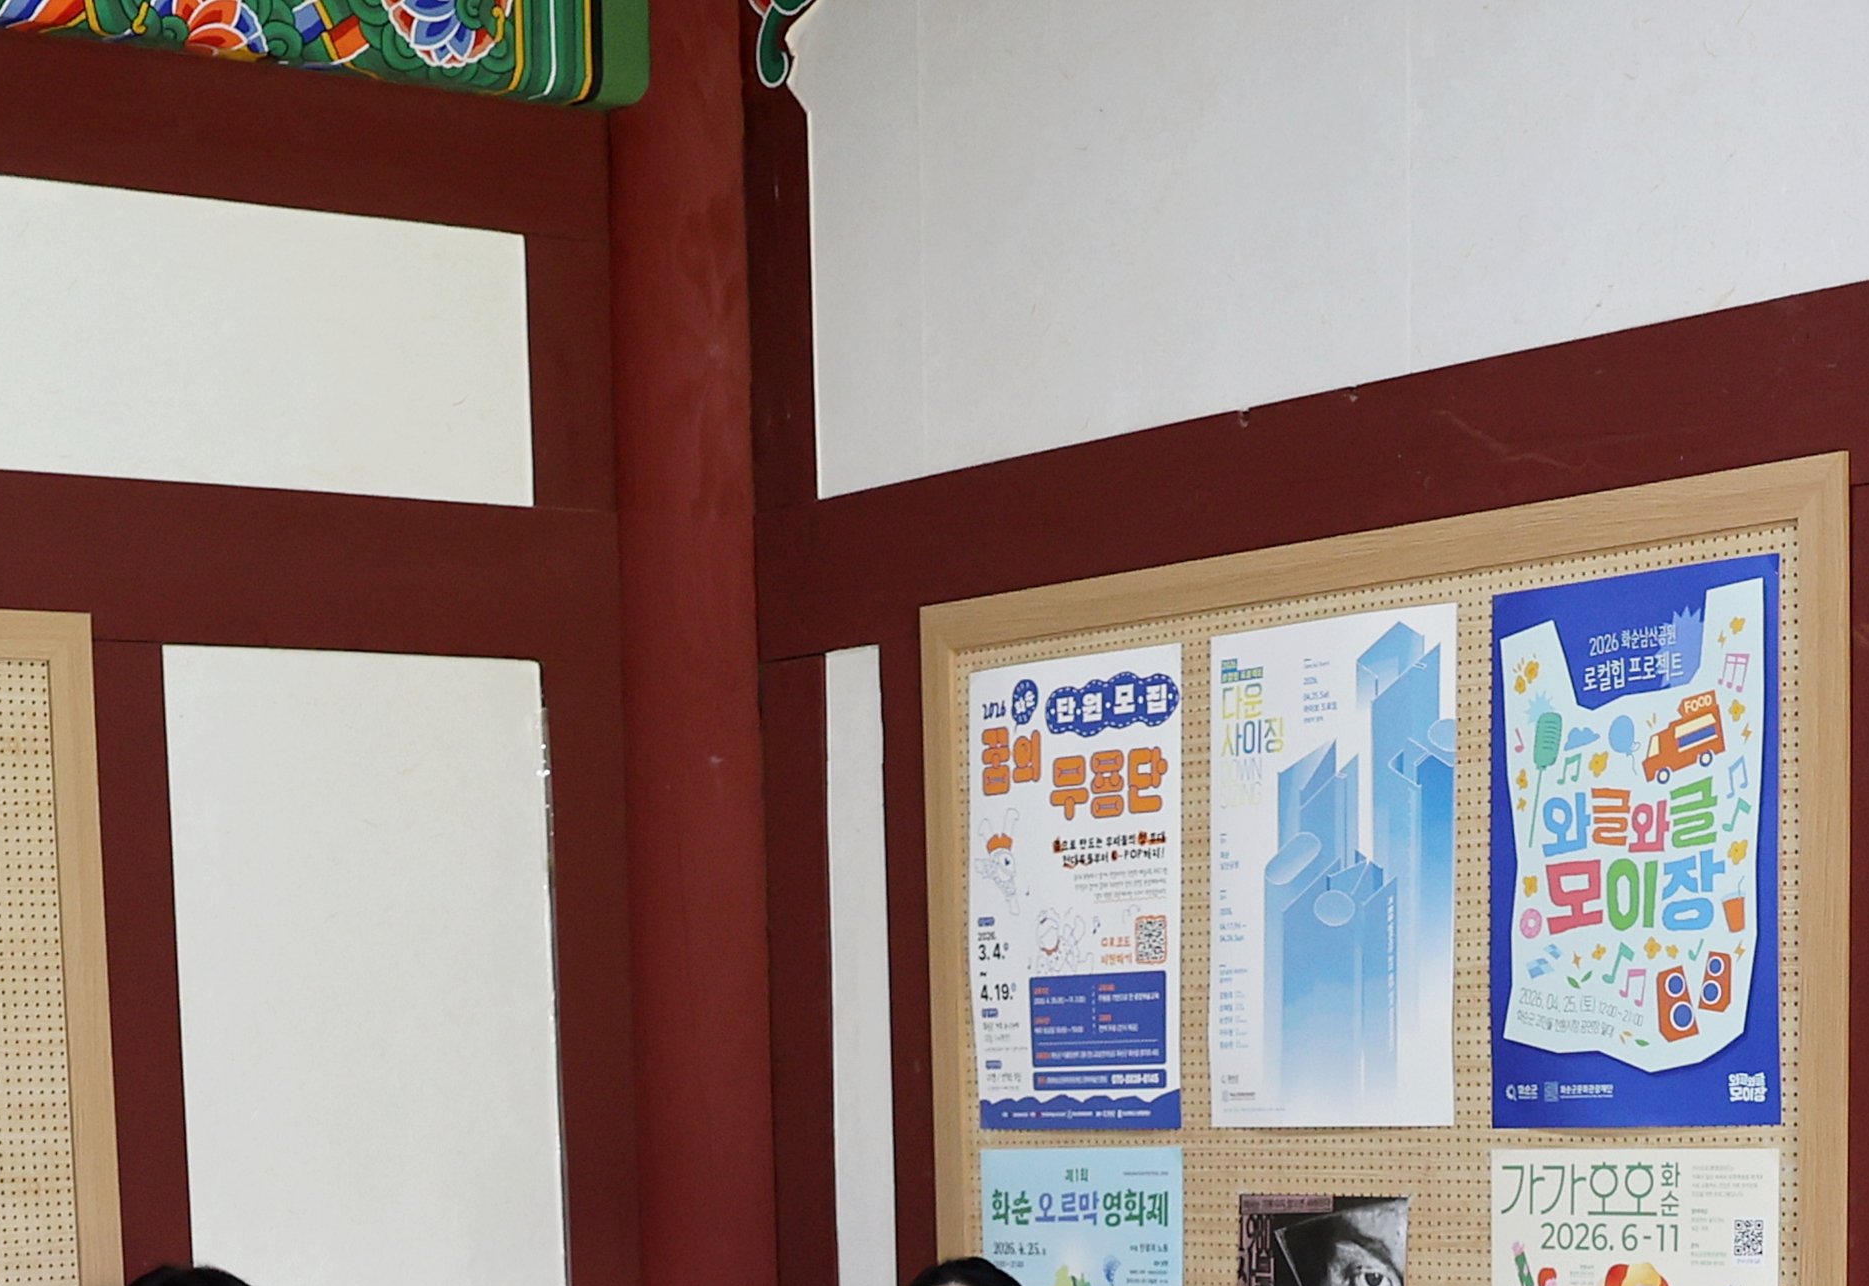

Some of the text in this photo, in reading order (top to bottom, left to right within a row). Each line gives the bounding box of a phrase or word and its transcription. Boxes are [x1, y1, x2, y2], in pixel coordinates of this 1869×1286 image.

[1588, 622, 1678, 657] 2026 화순남산공원
[1583, 653, 1684, 693] 로컬힙 프로젝트
[982, 699, 1007, 720] 2026
[1222, 683, 1263, 720] 다운
[1683, 693, 1713, 714] FOOD
[1221, 717, 1284, 757] 사이징
[982, 726, 1042, 797] 꿈의
[1050, 746, 1169, 822] 무용단
[1542, 776, 1719, 857] 와글와글
[1545, 849, 1726, 936] 모이장
[991, 1189, 1169, 1228] 화순 오르막 영화제
[1500, 1161, 1658, 1217] 가가호호
[1660, 1161, 1681, 1218] 화순
[1540, 1222, 1615, 1252] 2026.
